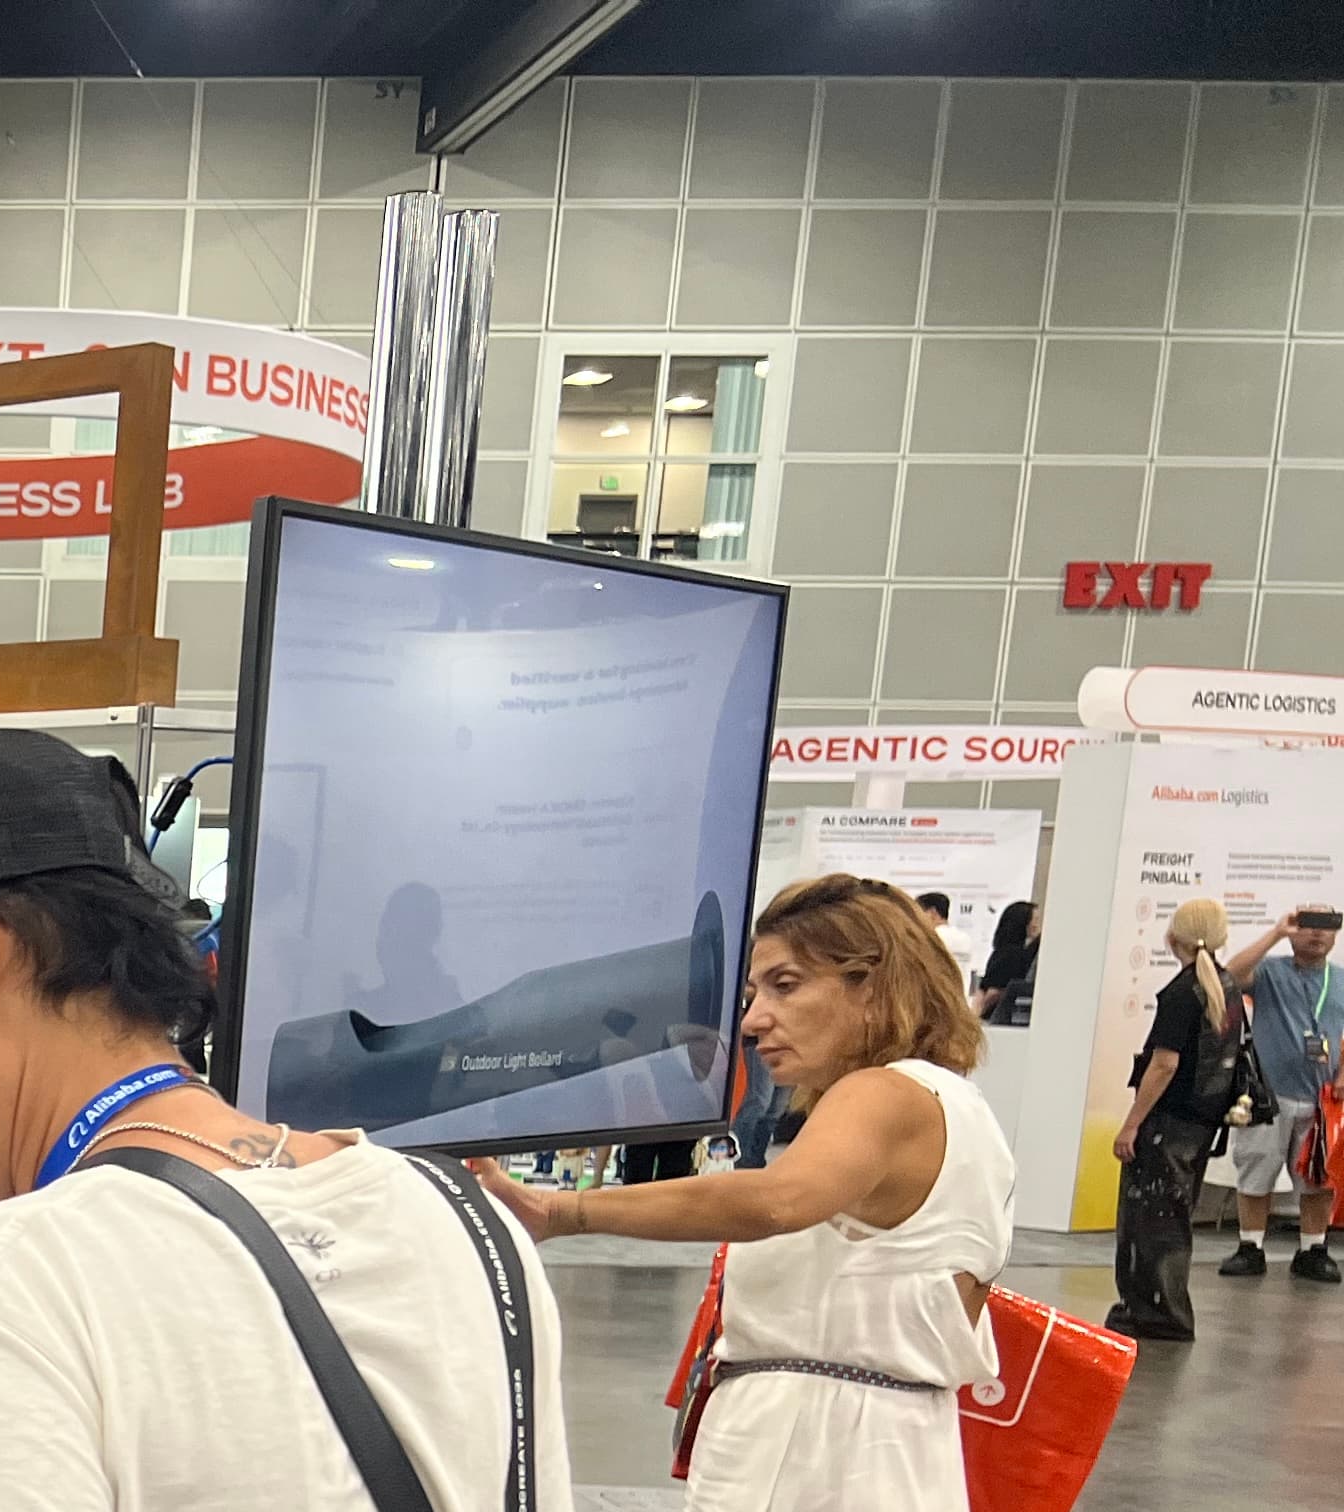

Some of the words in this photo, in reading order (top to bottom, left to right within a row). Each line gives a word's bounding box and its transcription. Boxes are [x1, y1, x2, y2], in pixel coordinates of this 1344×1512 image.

[206, 353, 370, 435] BUSINESS
[1062, 561, 1213, 611] EXIT
[1191, 690, 1260, 711] AGENTIC
[1264, 695, 1337, 715] LOGISTICS
[771, 736, 949, 763] AGENTIC
[85, 1069, 180, 1124] Alibaba.com
